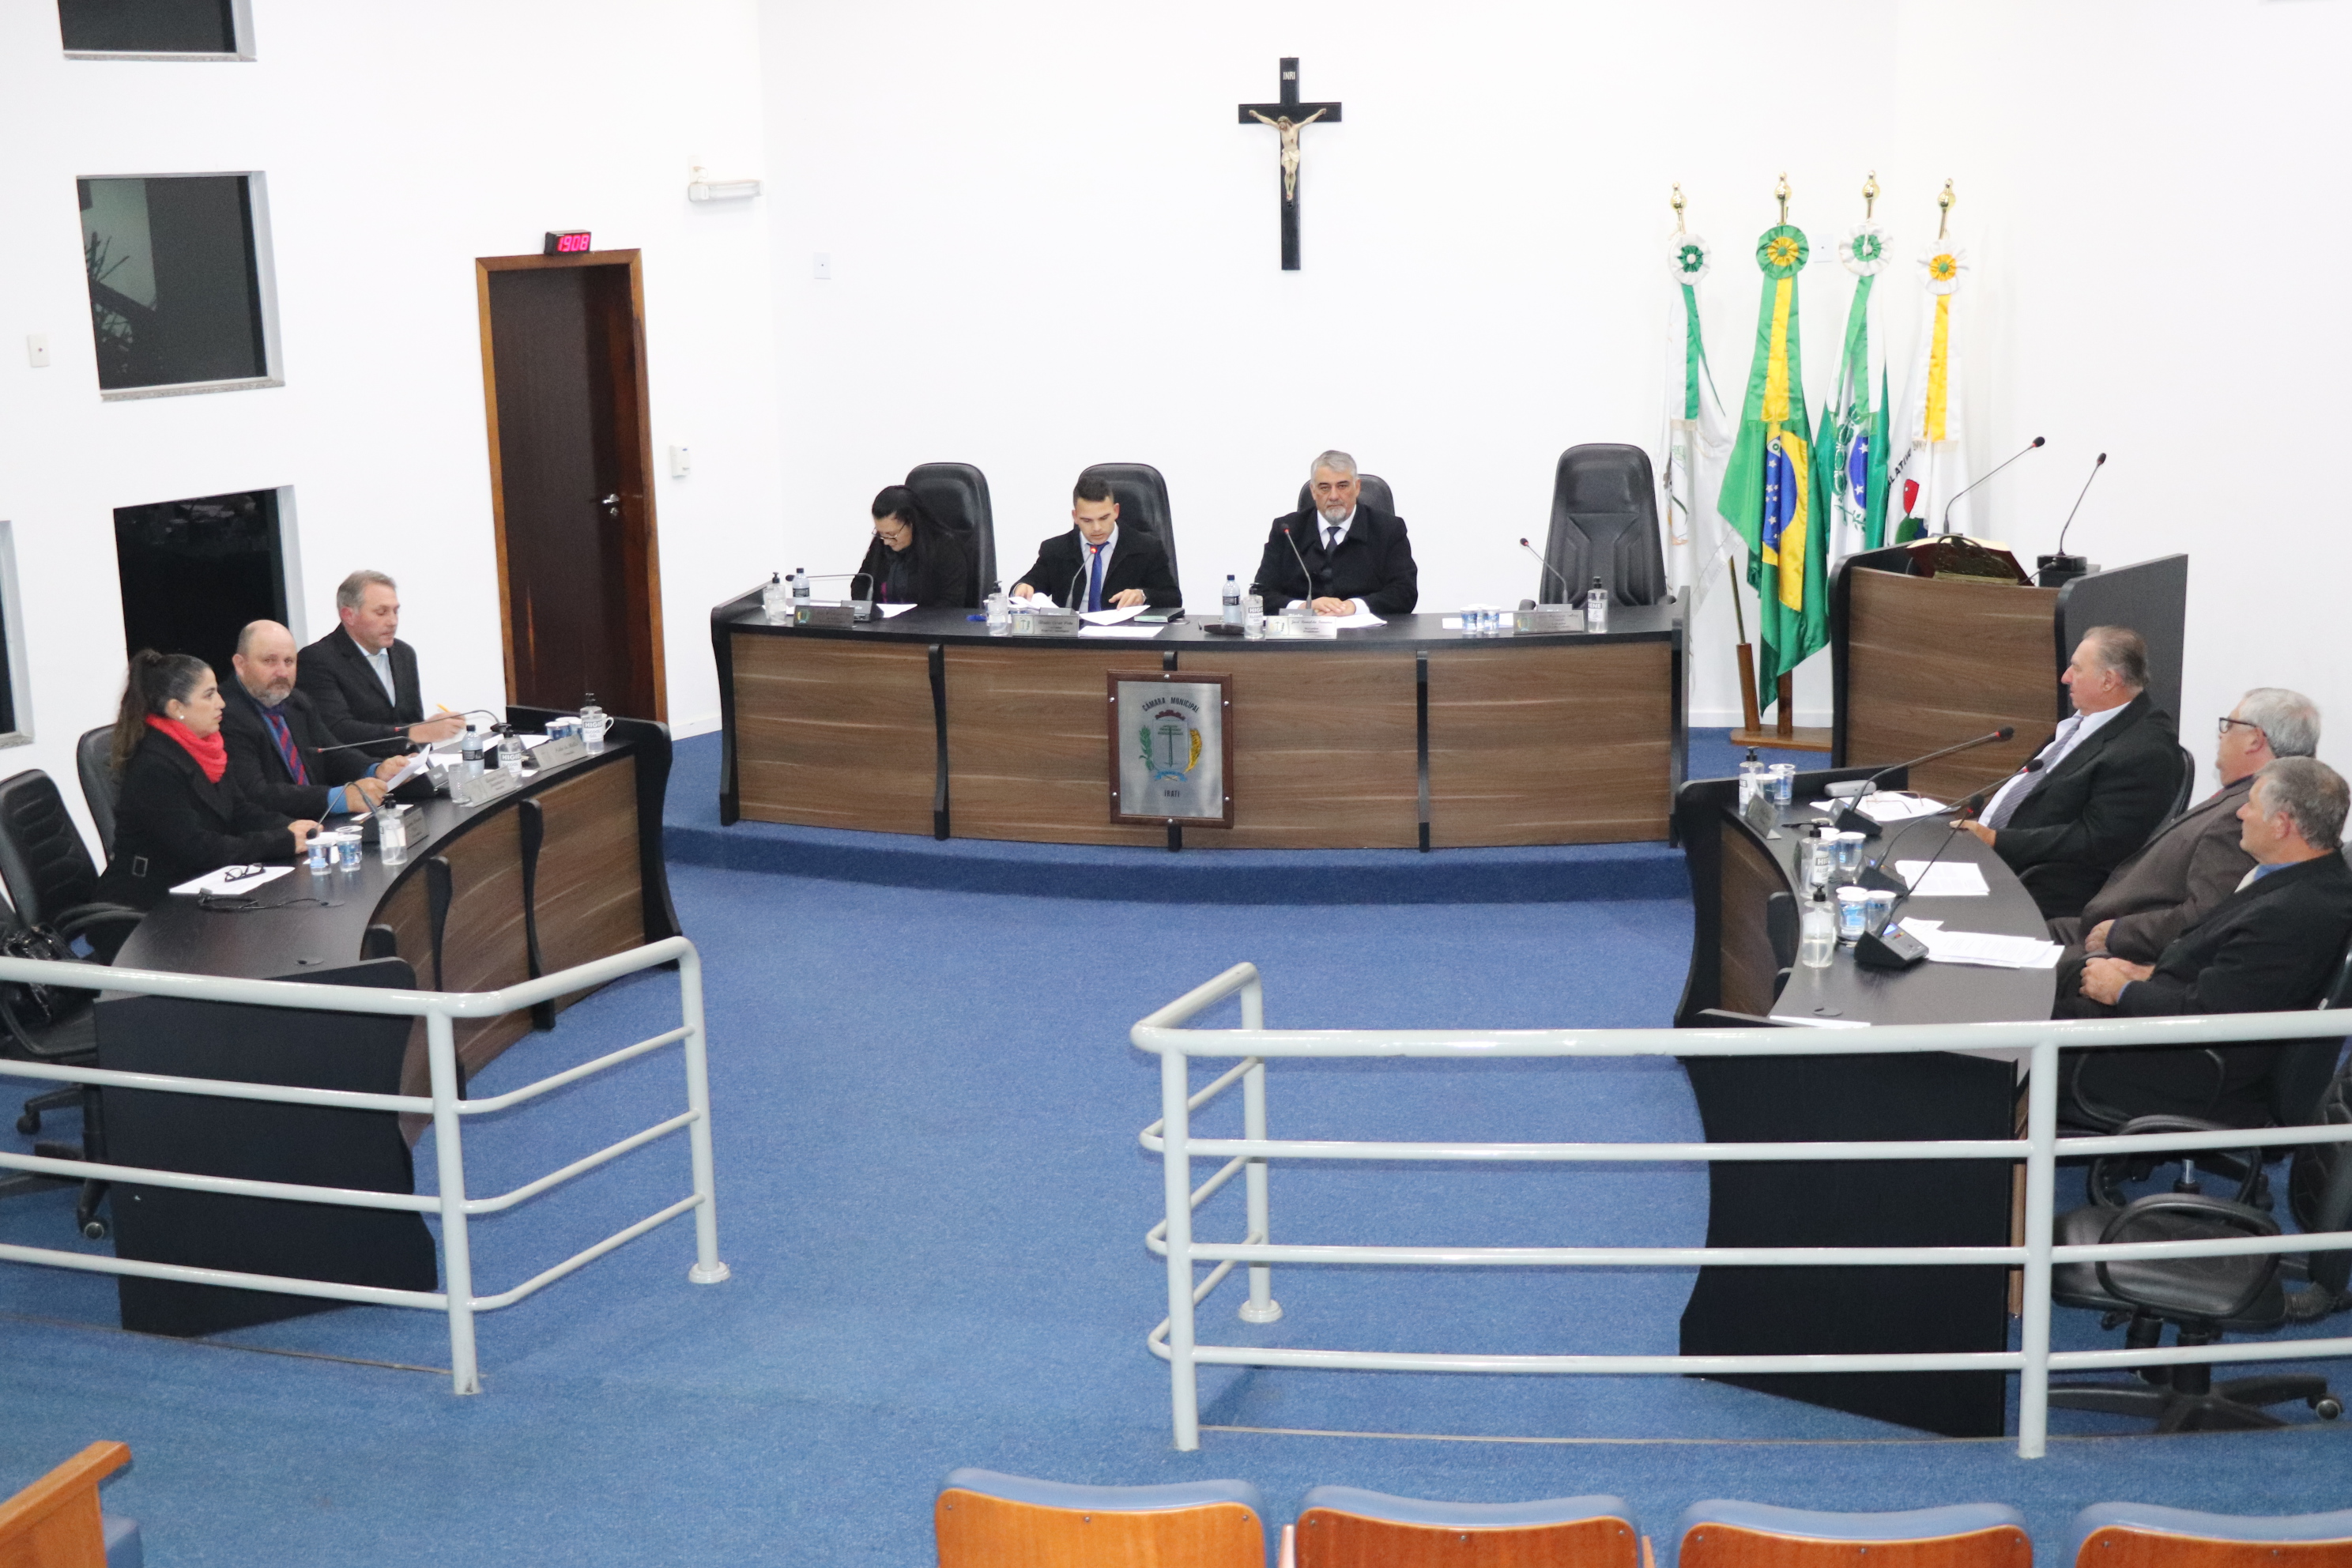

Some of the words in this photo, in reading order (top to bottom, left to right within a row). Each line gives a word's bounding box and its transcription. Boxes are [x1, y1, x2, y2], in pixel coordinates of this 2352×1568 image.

[1283, 71, 1296, 81] INRI
[557, 233, 590, 252] 1908
[1170, 696, 1200, 713] MUNICIPAL
